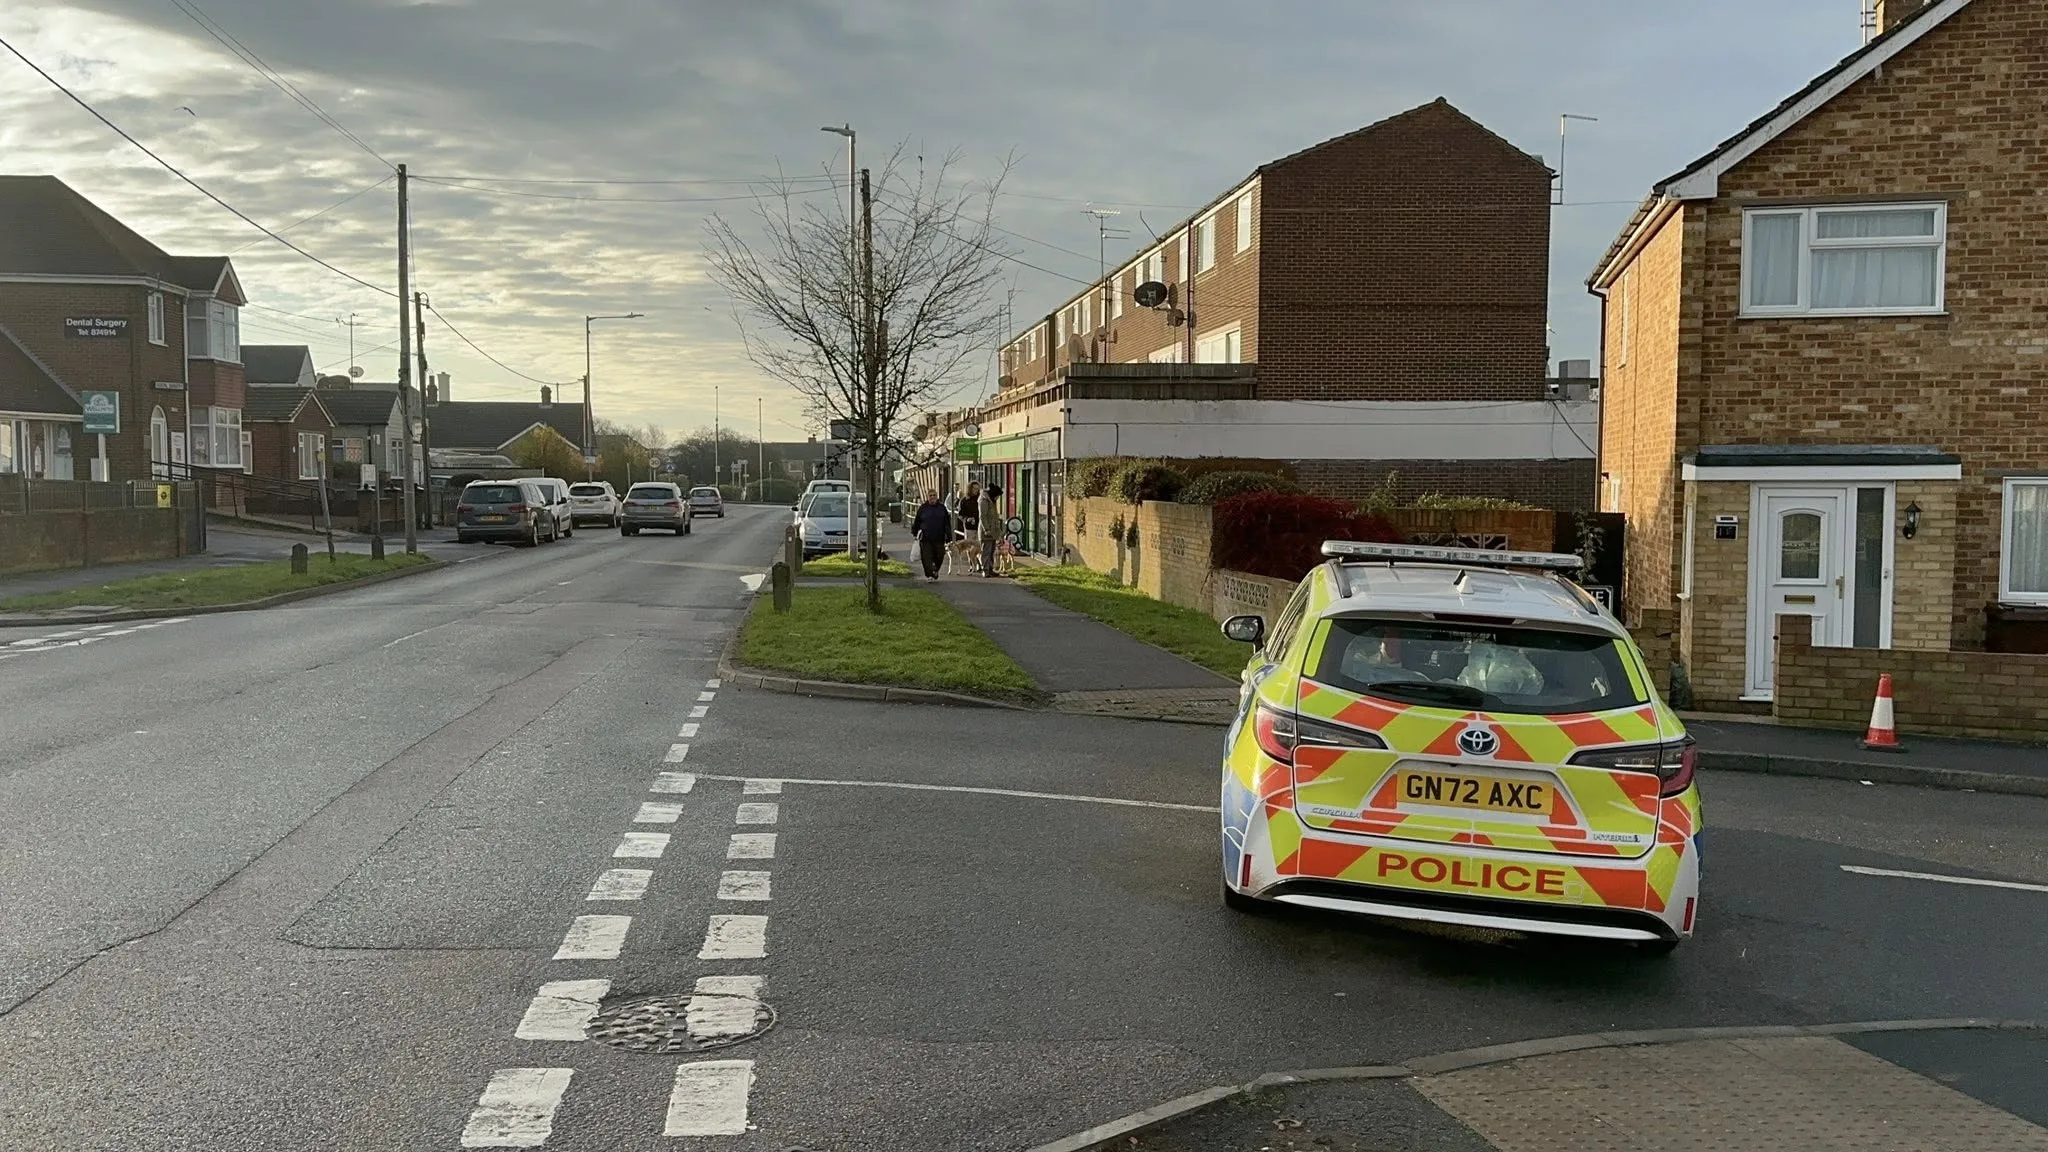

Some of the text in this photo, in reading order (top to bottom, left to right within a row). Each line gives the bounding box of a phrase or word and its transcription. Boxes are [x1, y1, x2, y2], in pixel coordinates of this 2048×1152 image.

[66, 318, 127, 327] Dental Surgery
[1406, 774, 1543, 810] GN72 AXC
[1377, 853, 1566, 896] POLICE
